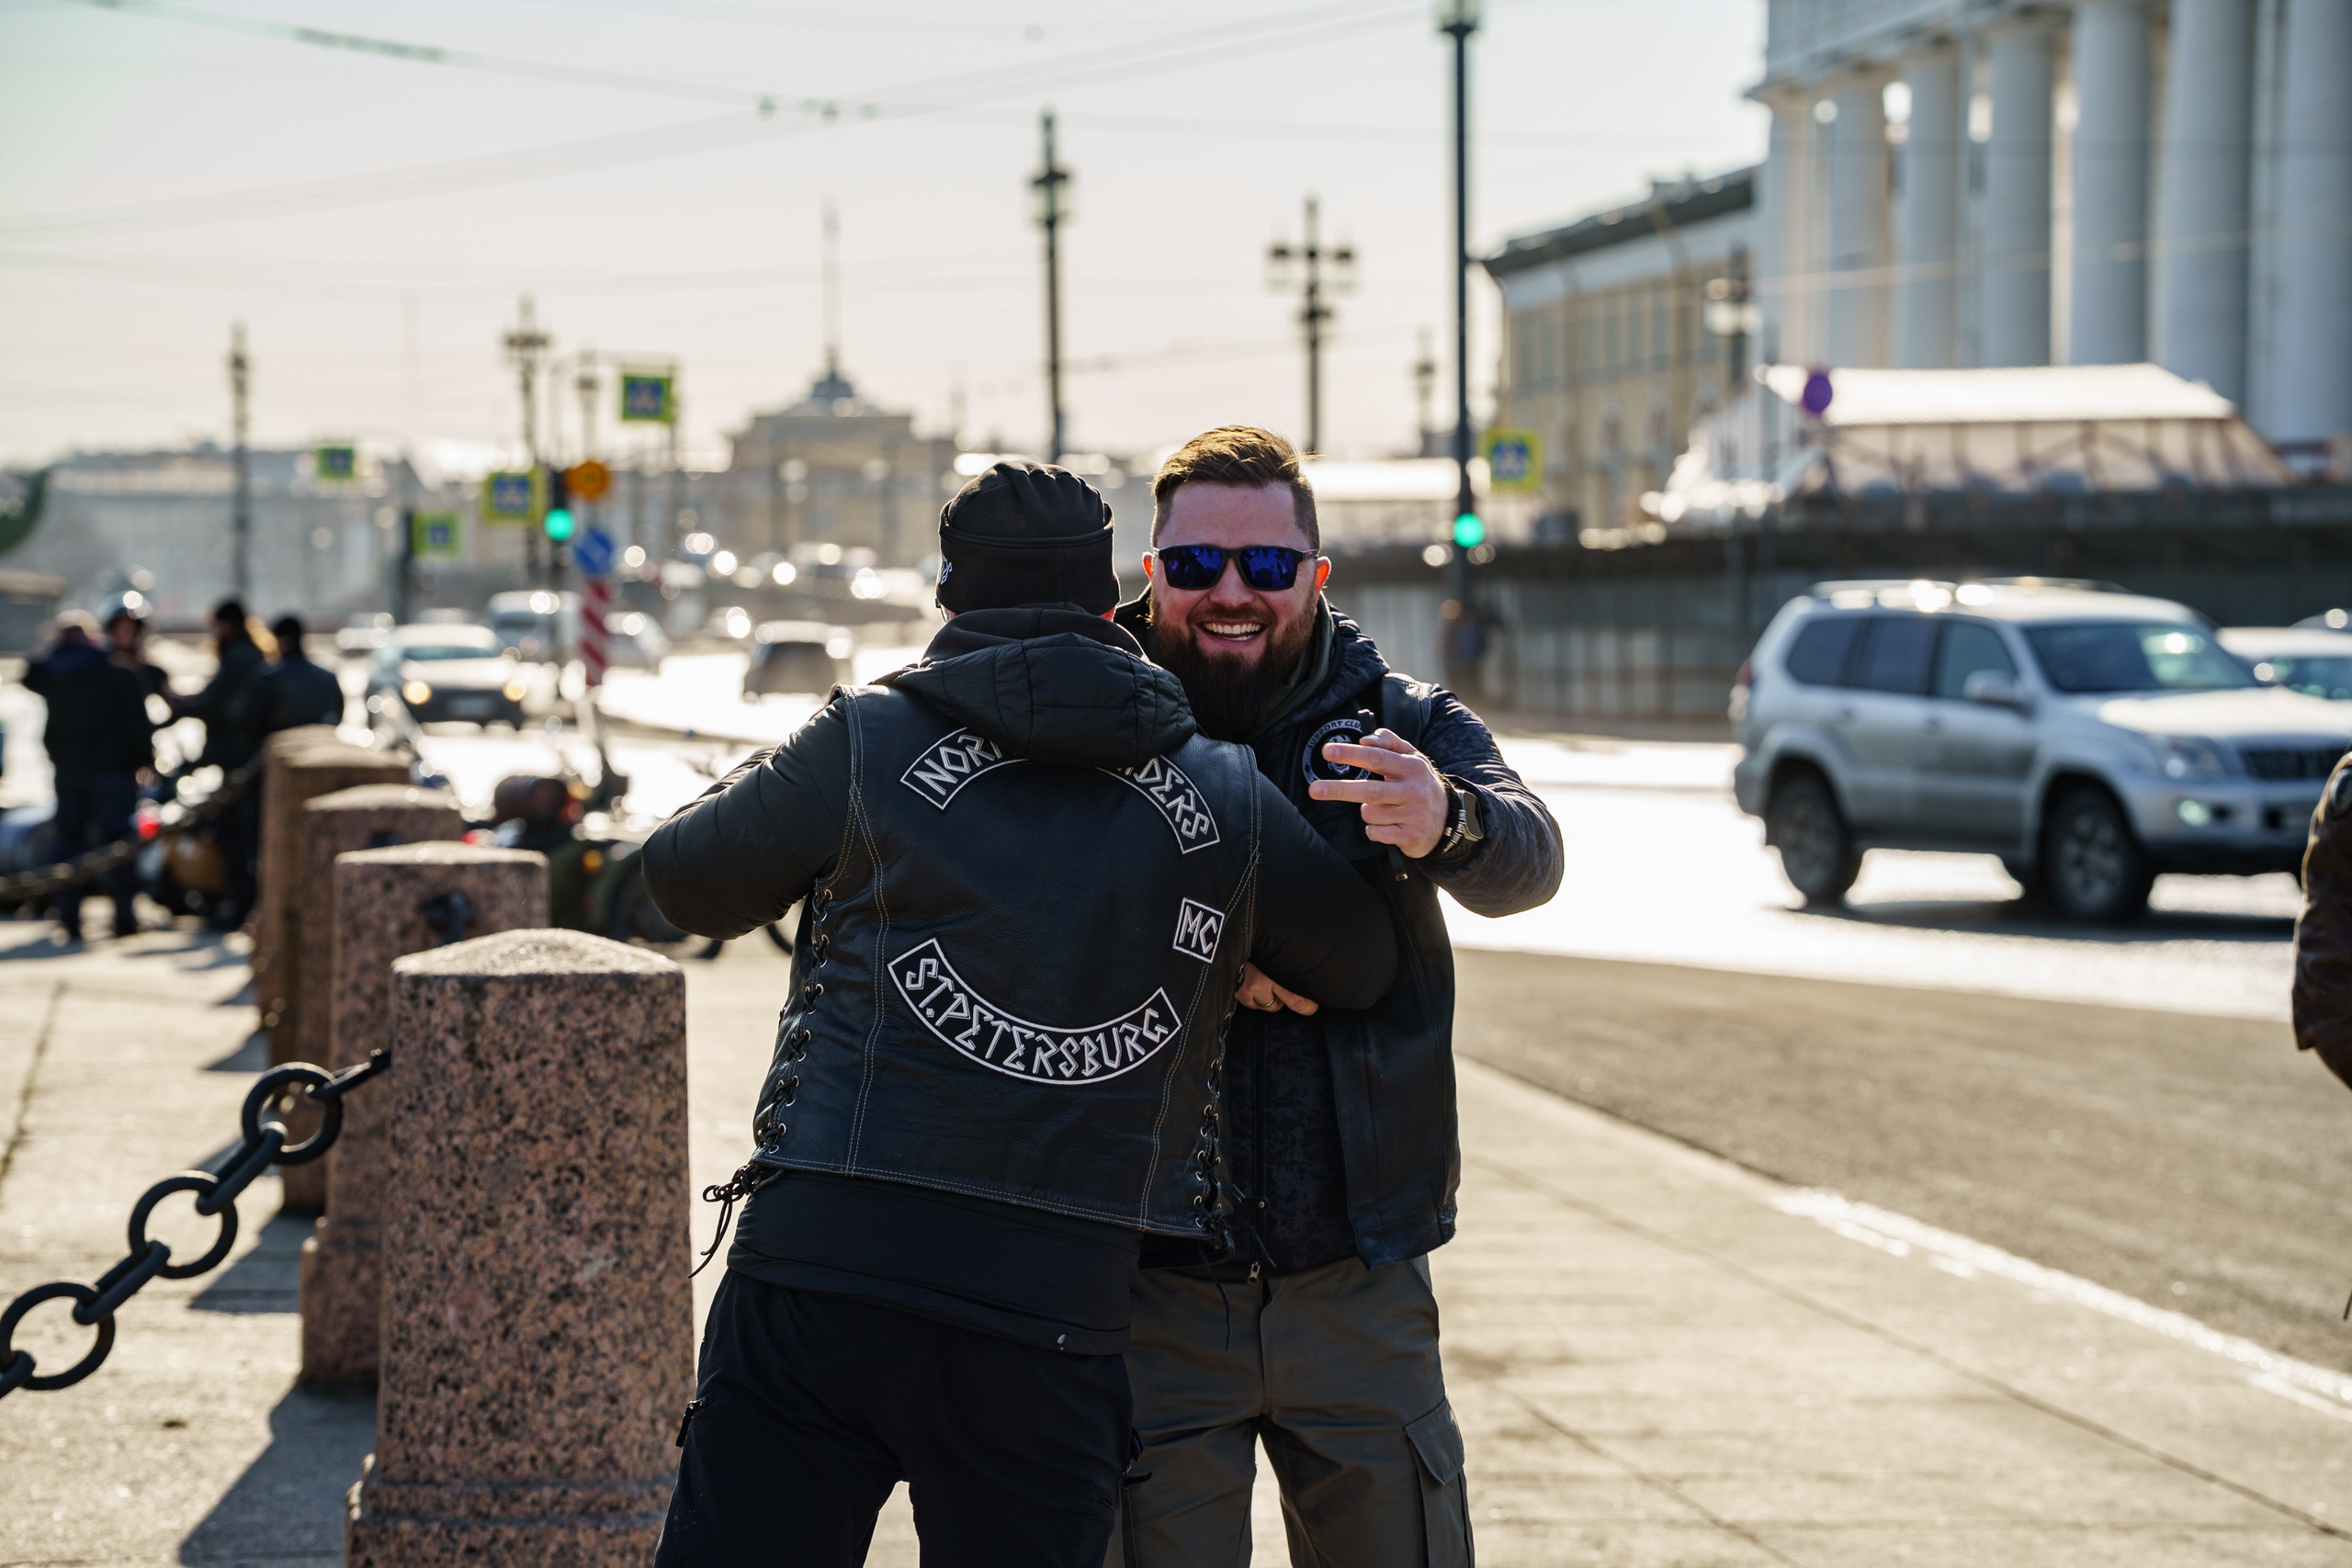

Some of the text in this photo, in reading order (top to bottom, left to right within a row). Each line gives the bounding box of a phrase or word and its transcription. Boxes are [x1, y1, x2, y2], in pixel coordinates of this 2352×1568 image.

[1307, 720, 1363, 749] SUPPORT CLU
[1179, 905, 1218, 954] MC
